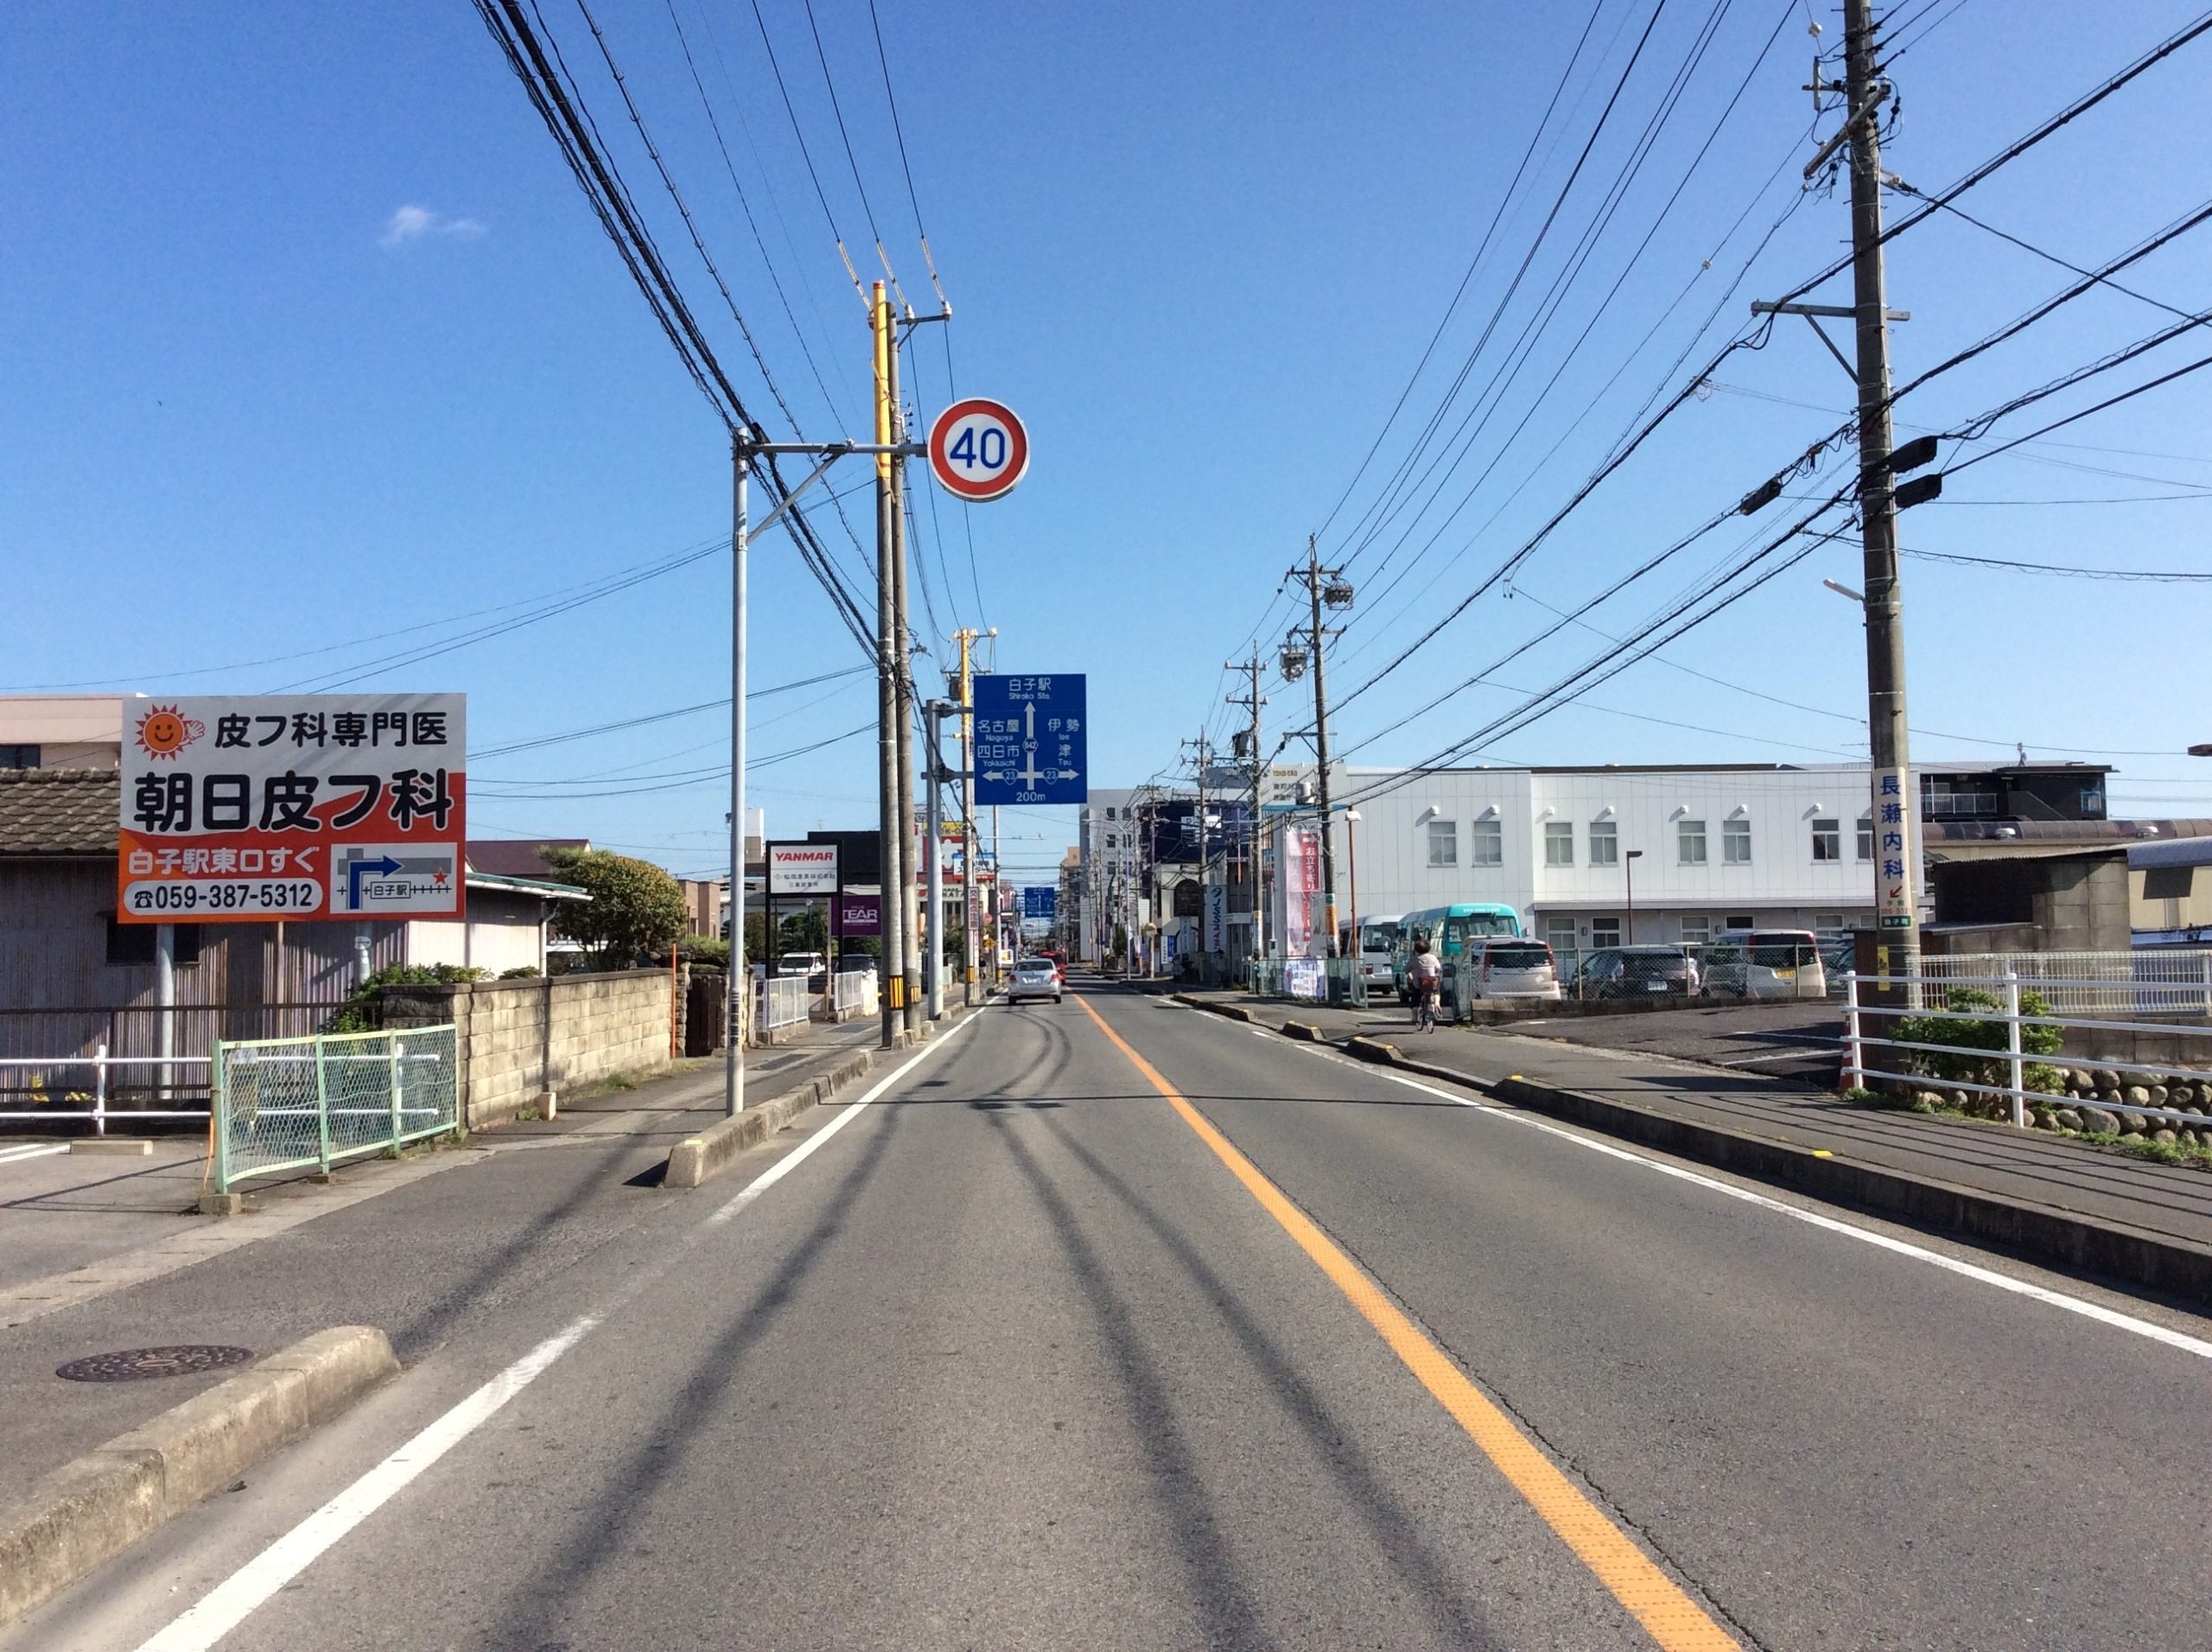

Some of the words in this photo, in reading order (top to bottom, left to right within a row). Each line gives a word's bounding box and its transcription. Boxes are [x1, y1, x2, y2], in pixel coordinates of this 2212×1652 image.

[950, 427, 1005, 469] 40
[1008, 677, 1052, 691] 白子駅
[215, 711, 448, 748] 皮フ科専門医
[977, 719, 1020, 733] 名古屋
[1047, 718, 1079, 732] 伊勢
[977, 745, 1020, 759] 四日市
[1058, 744, 1071, 758] 津
[134, 768, 452, 833] 朝日皮フ科
[1016, 791, 1046, 802] 200m
[1880, 775, 1904, 880] 長瀬内科
[129, 847, 320, 874] 白子駅東口すぐ
[775, 852, 834, 861] YANMAR
[156, 883, 313, 909] 059-387-5312
[374, 885, 407, 896] 白子駅
